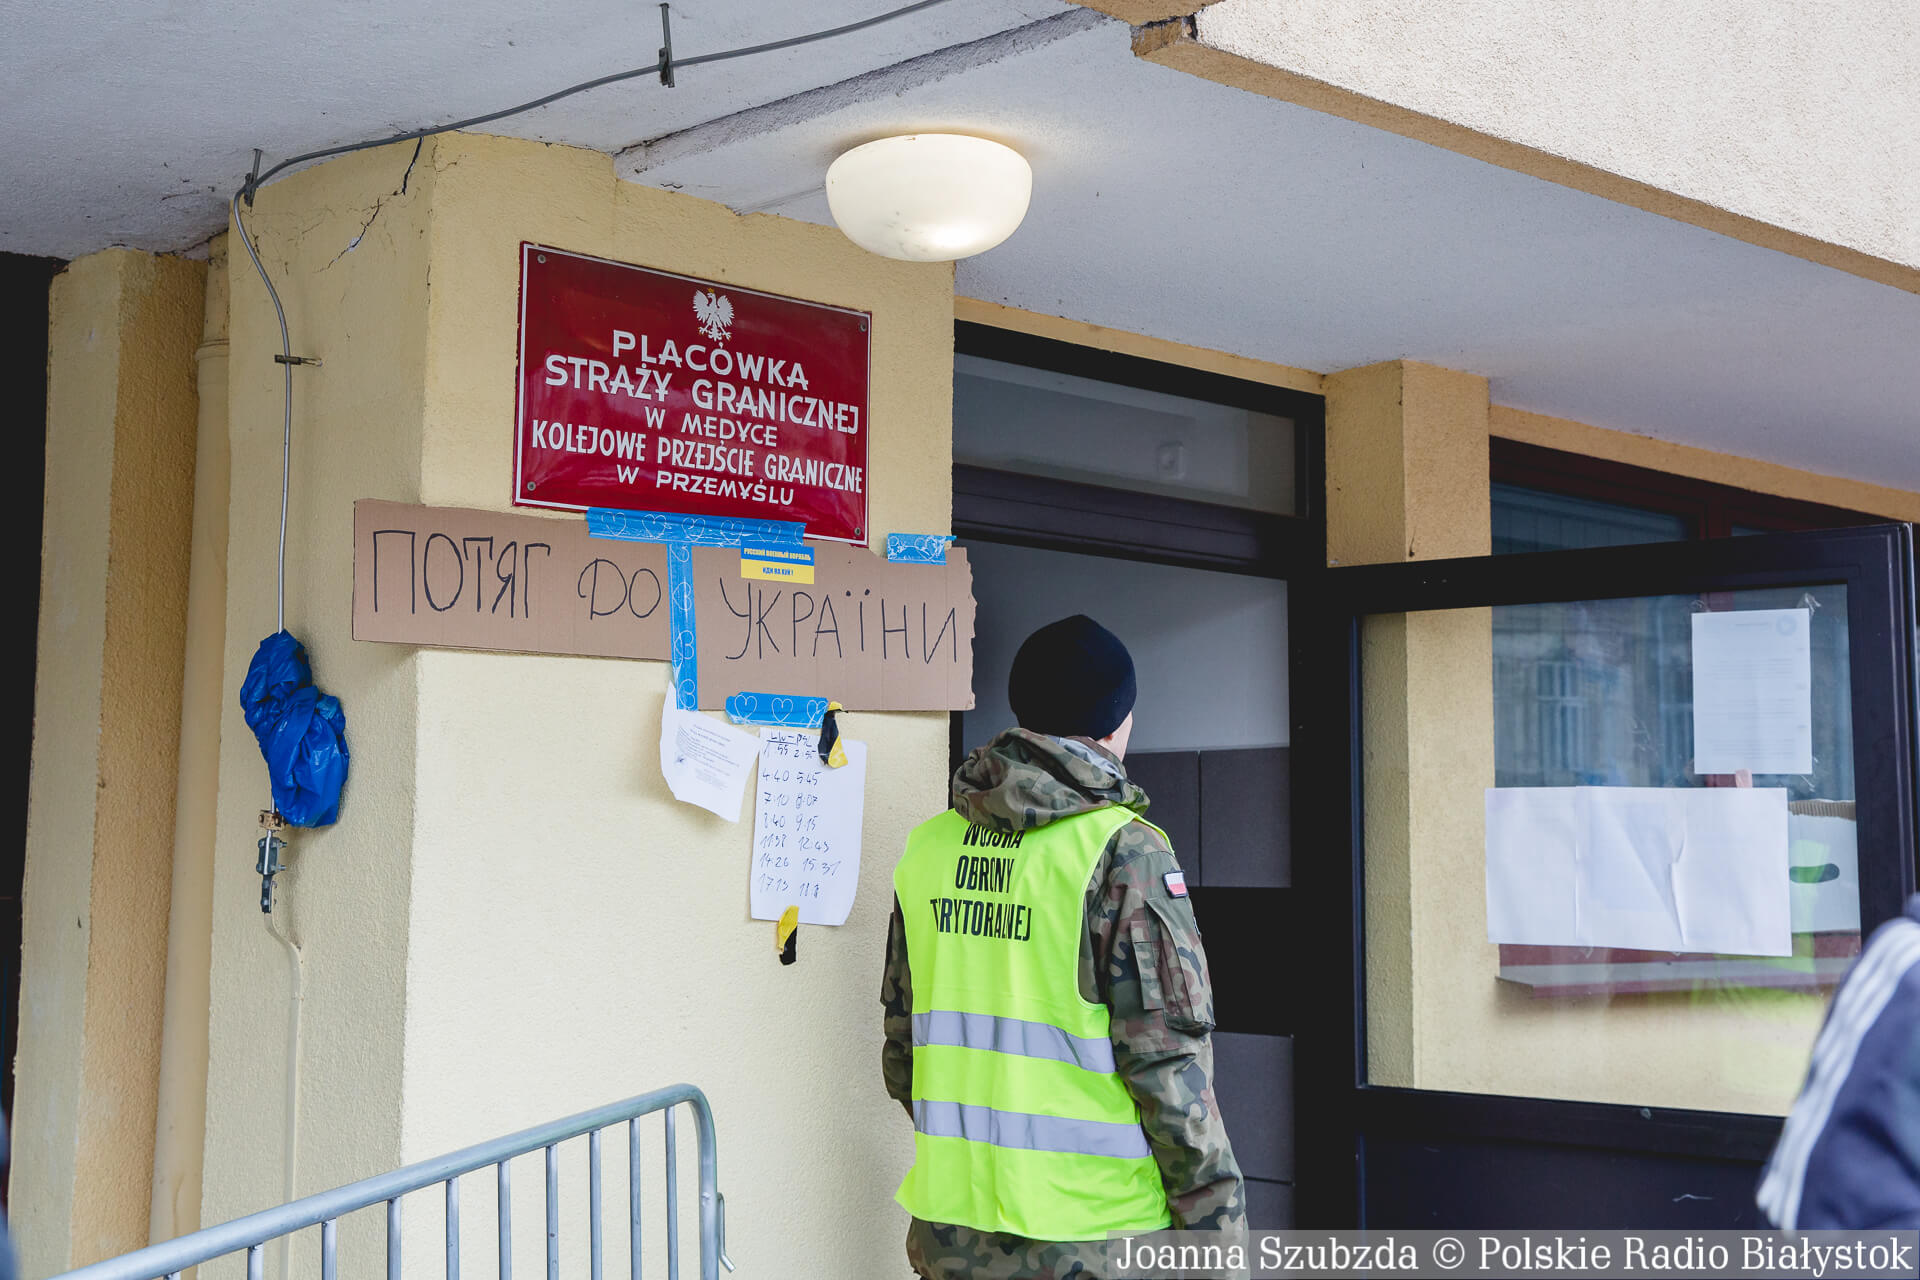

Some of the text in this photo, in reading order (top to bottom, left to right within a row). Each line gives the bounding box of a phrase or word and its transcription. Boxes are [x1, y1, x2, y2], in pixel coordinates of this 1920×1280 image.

[545, 354, 859, 434] STRAŻY GRANICZNEJ
[613, 329, 809, 391] PLACÓWKA
[532, 419, 863, 494] KOLEJOWE PRZEJŚCIE GRANICZNE
[644, 406, 778, 447] W MEDYCE
[616, 464, 794, 505] W PRZEMYŚLU
[372, 529, 957, 665] ПОТЯГ ДО УКРАЇНИ
